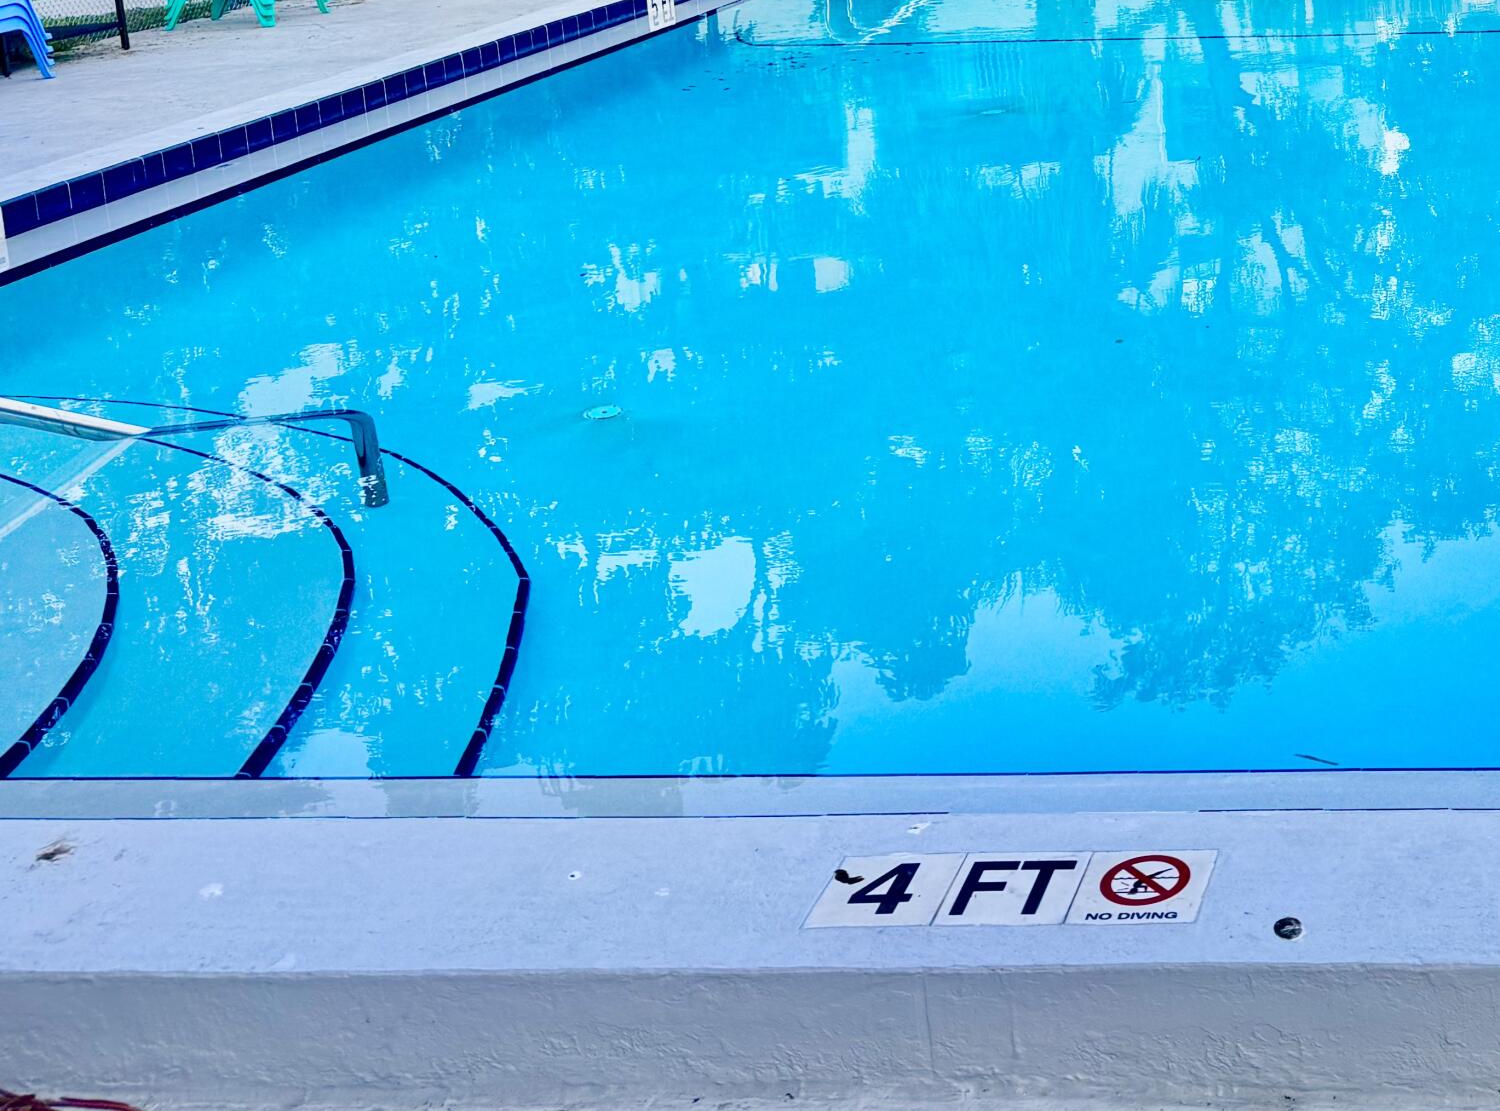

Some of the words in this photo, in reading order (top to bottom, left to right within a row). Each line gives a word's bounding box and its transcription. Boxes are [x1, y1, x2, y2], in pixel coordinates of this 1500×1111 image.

[847, 862, 921, 915] 4
[948, 860, 1078, 916] FT
[1085, 912, 1112, 920] NO
[1117, 911, 1178, 920] DIVING
